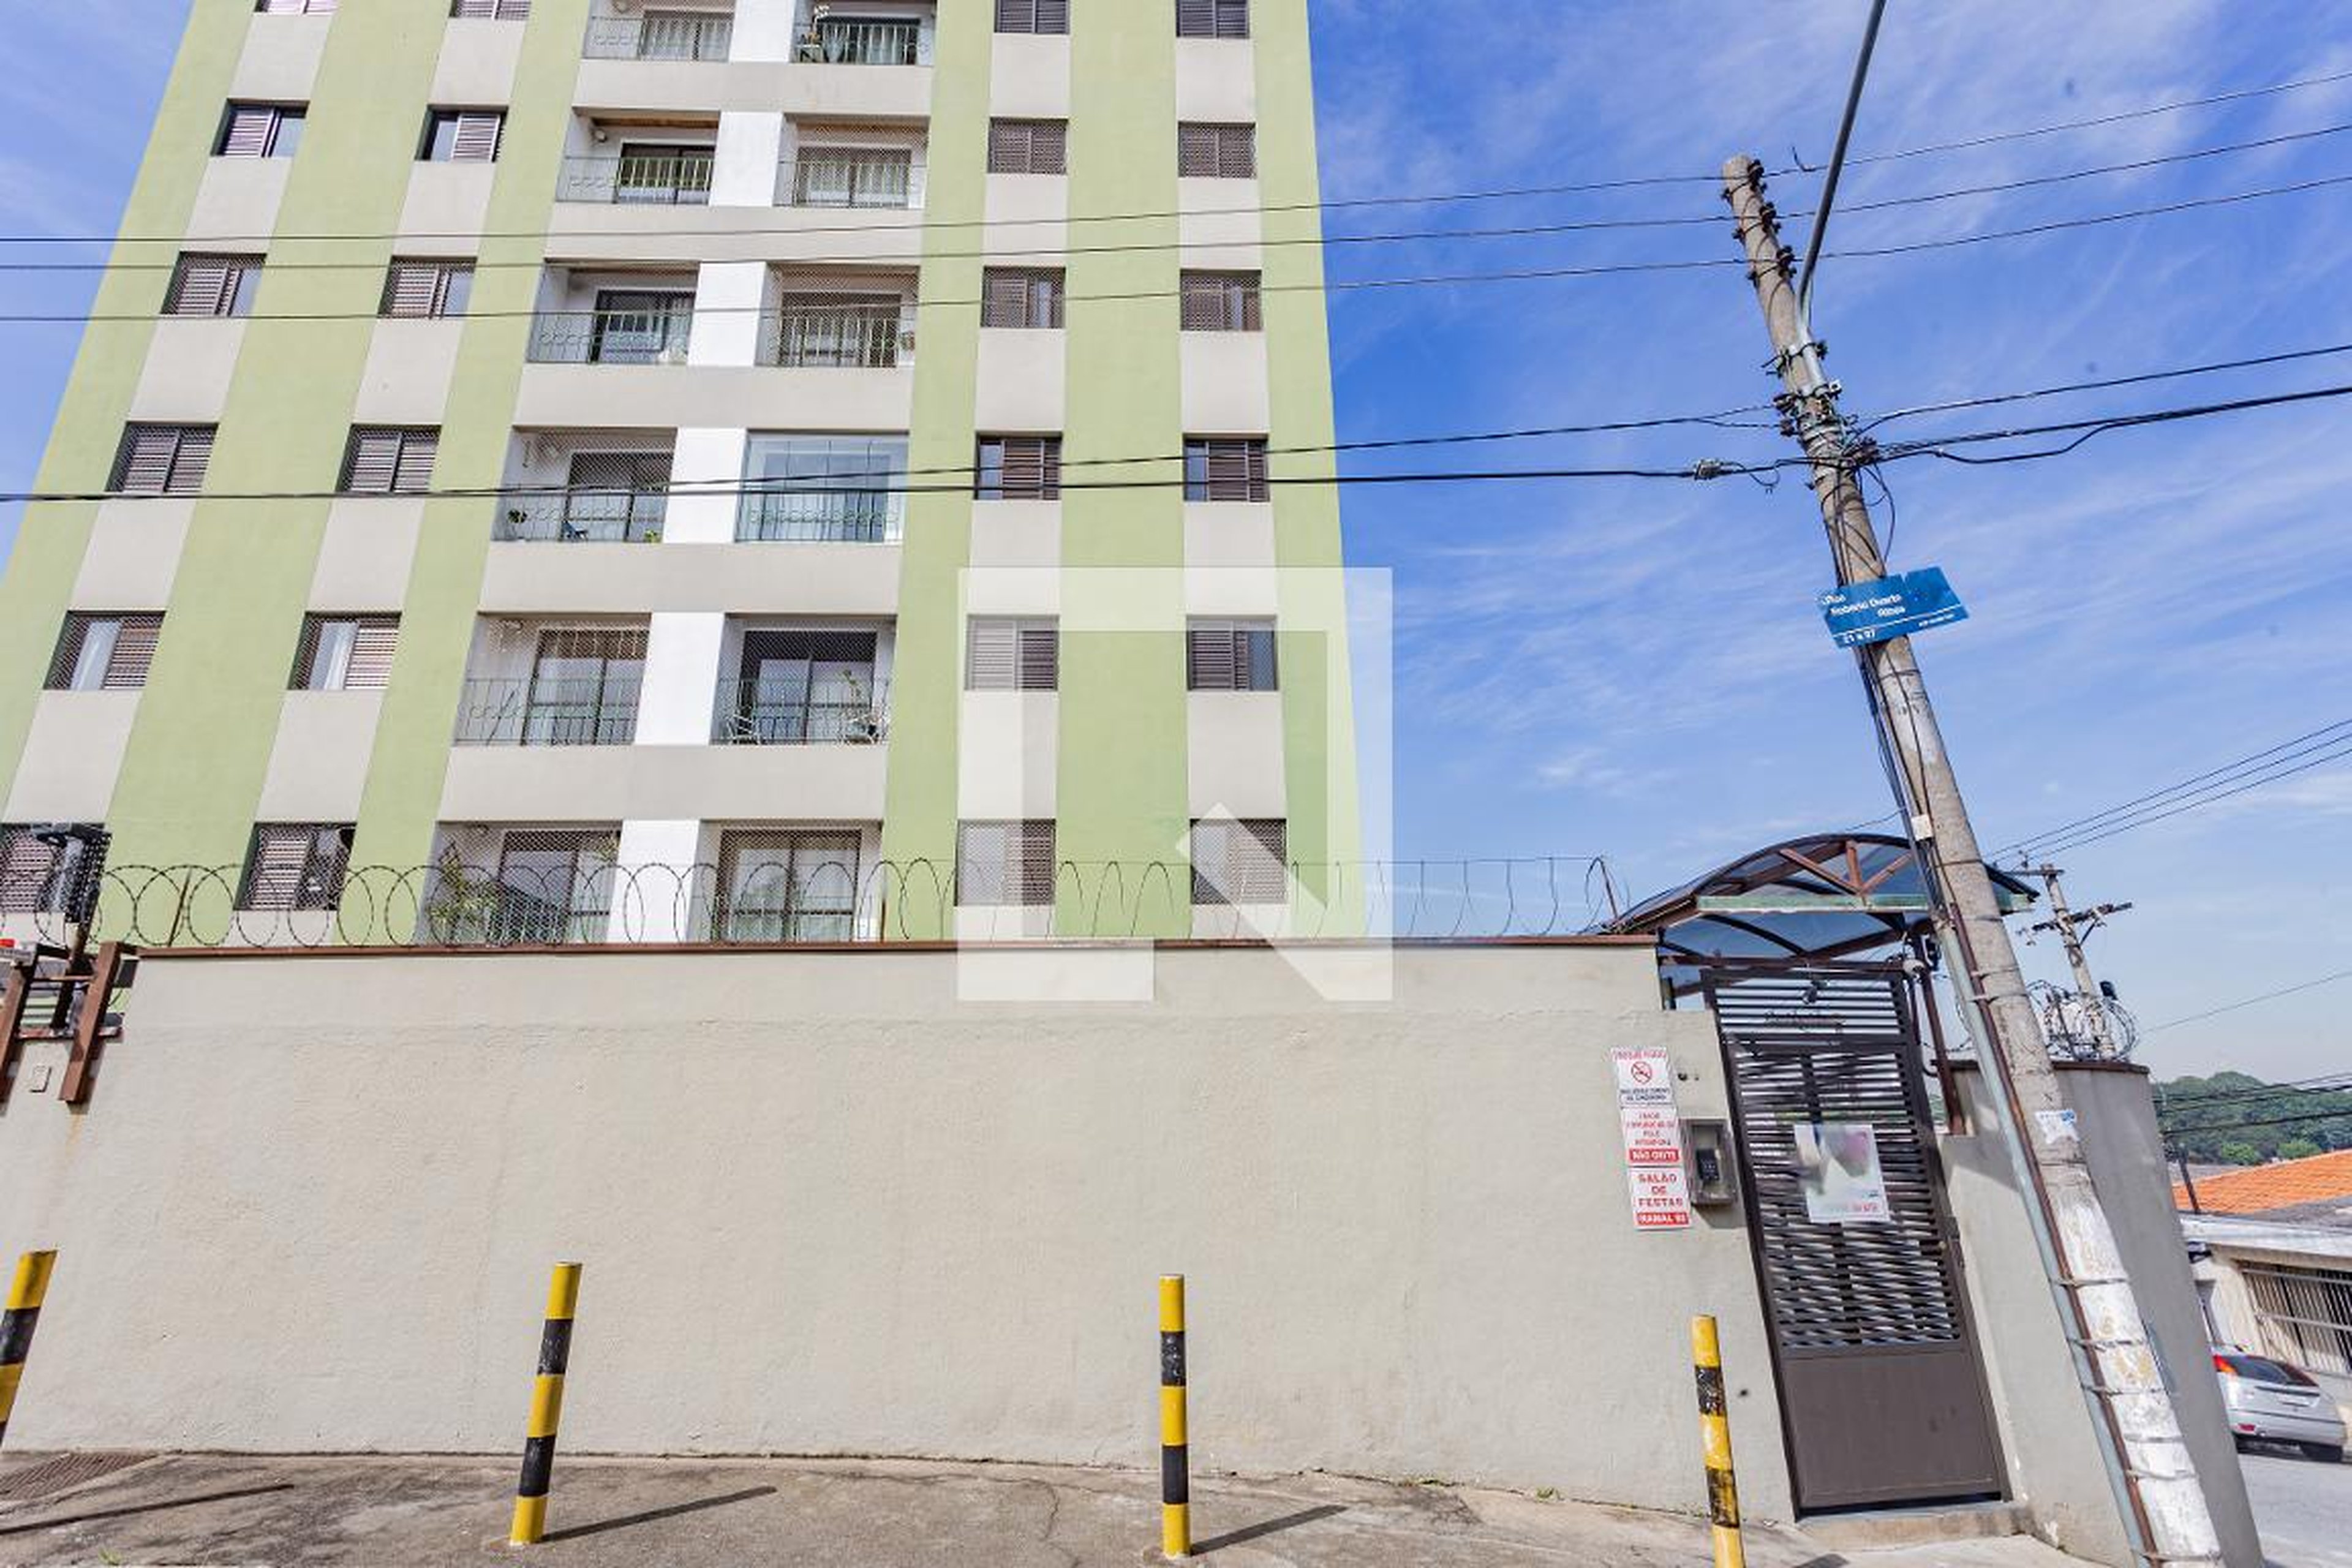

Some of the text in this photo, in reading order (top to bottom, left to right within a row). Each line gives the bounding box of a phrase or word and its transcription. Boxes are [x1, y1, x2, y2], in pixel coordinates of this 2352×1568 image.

[1638, 1172, 1677, 1183] SALÃO
[1651, 1186, 1666, 1195] DE
[1638, 1198, 1683, 1207] FESTAS
